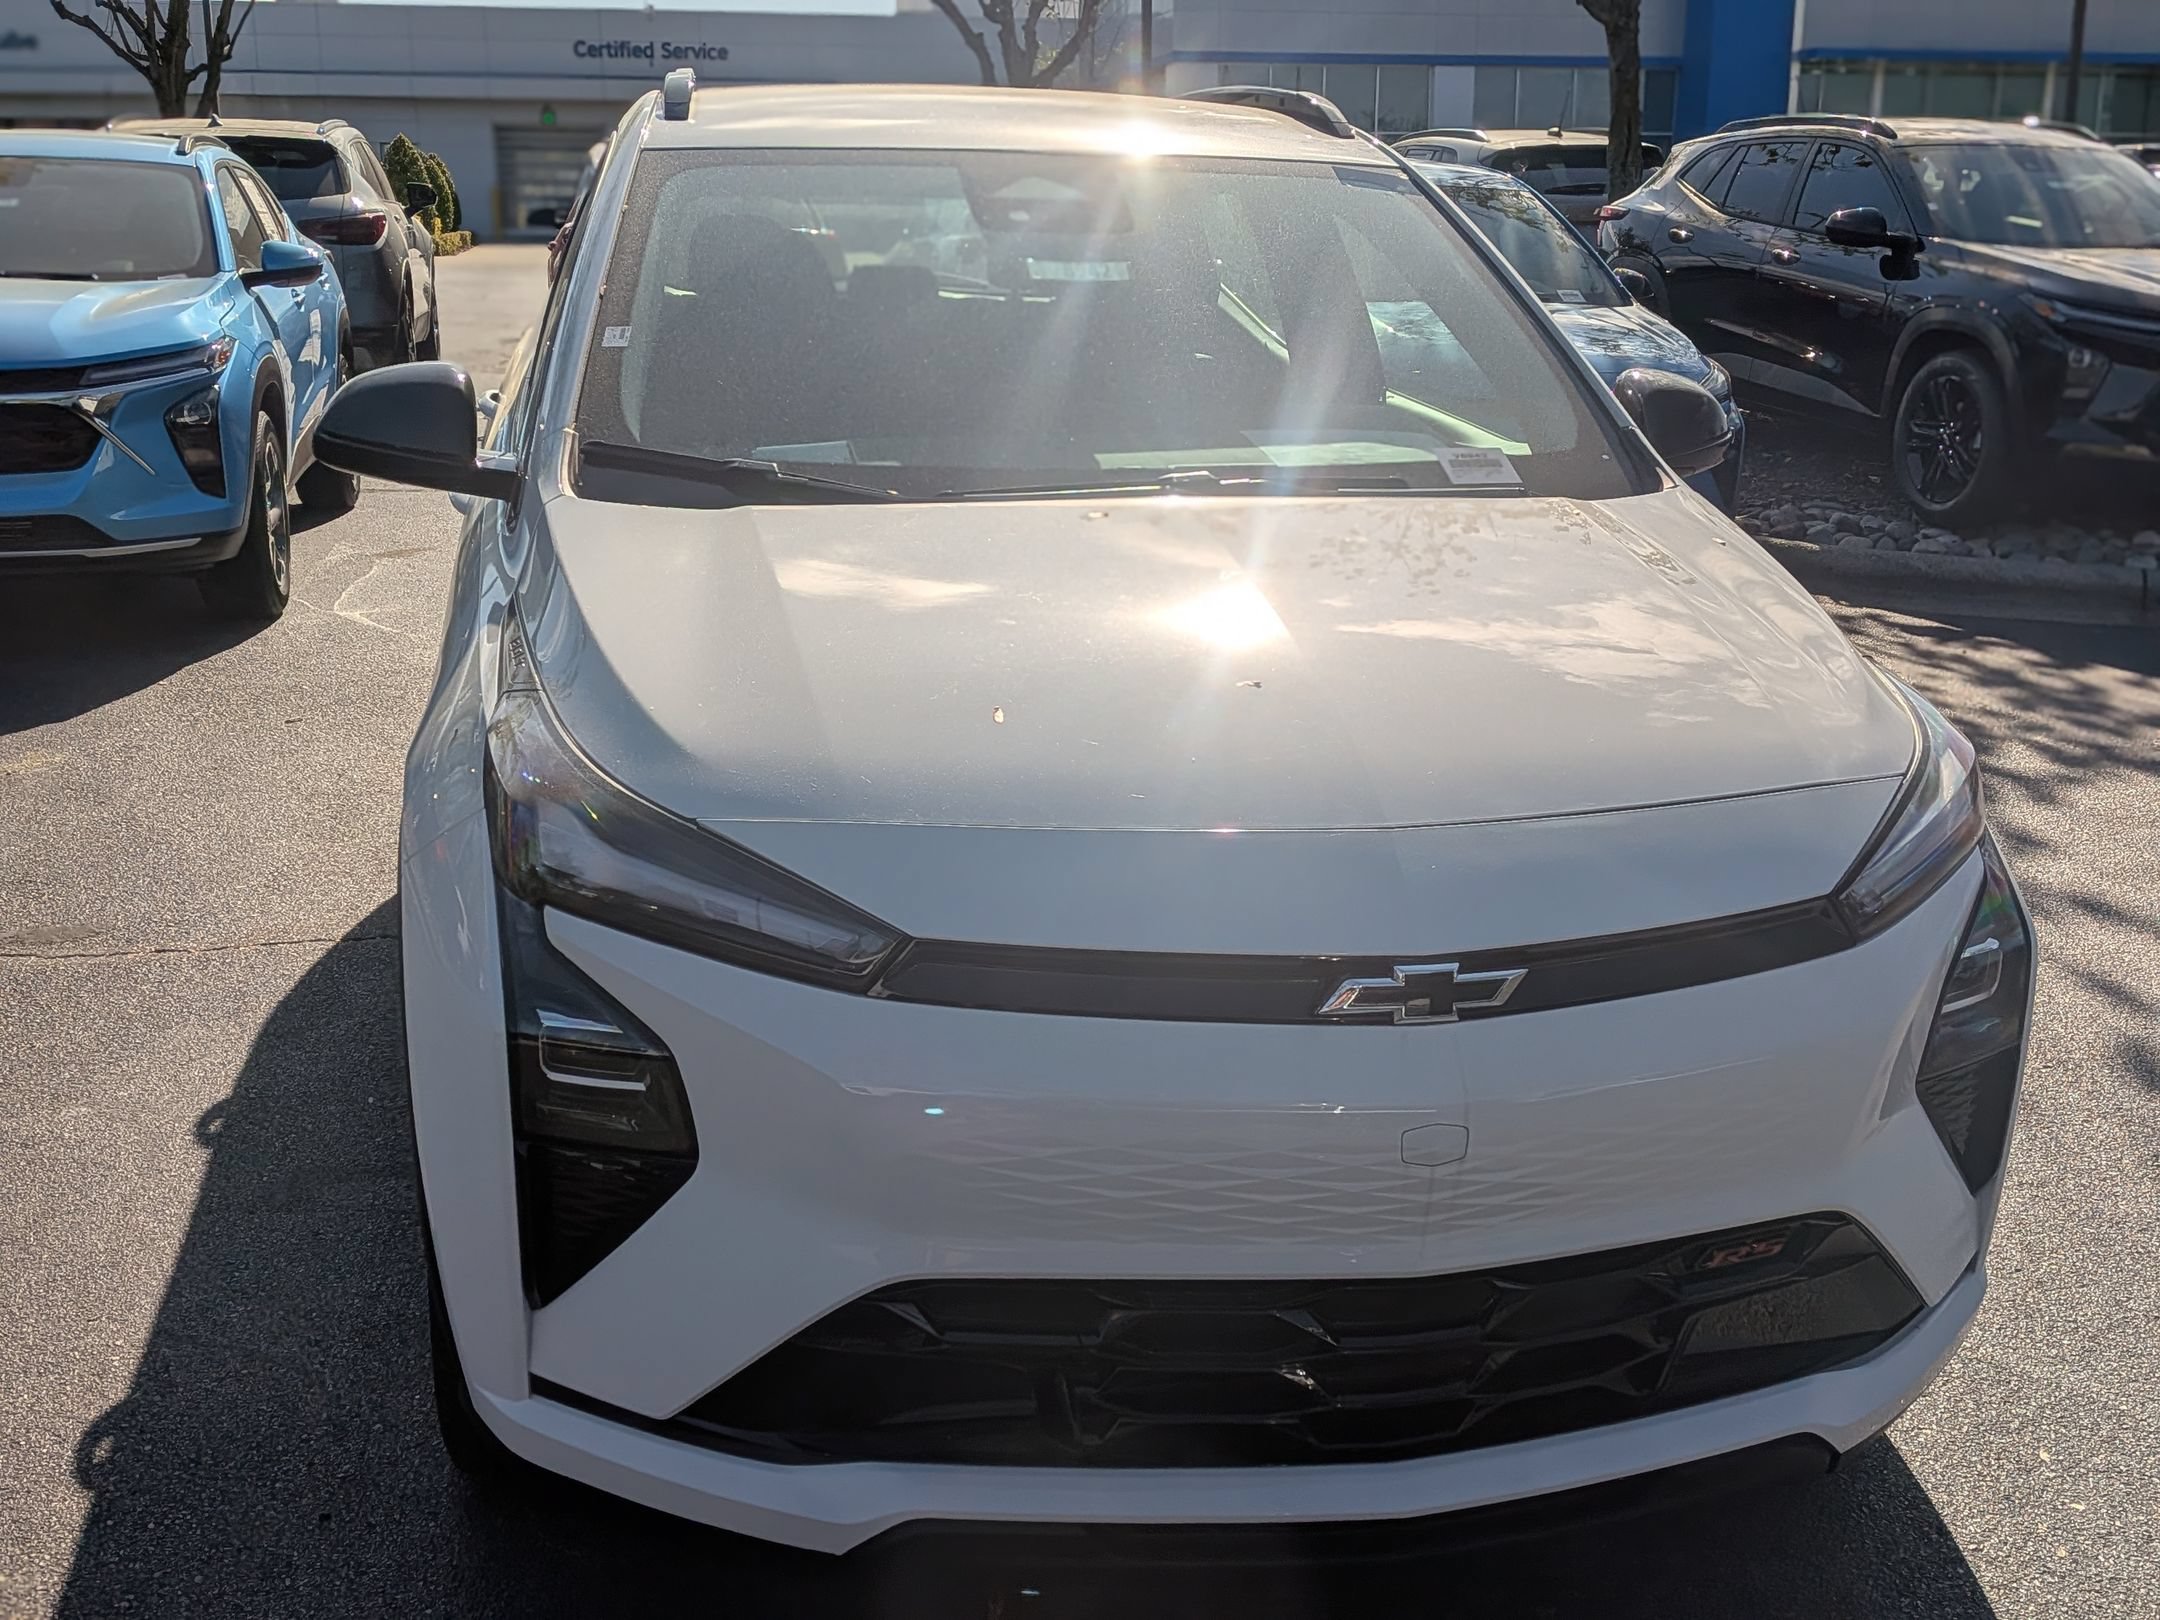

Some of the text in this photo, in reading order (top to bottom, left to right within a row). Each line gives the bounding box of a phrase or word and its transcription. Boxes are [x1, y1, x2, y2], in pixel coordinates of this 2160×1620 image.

[573, 39, 729, 60] Certified Service
[1703, 1240, 1784, 1269] RS
